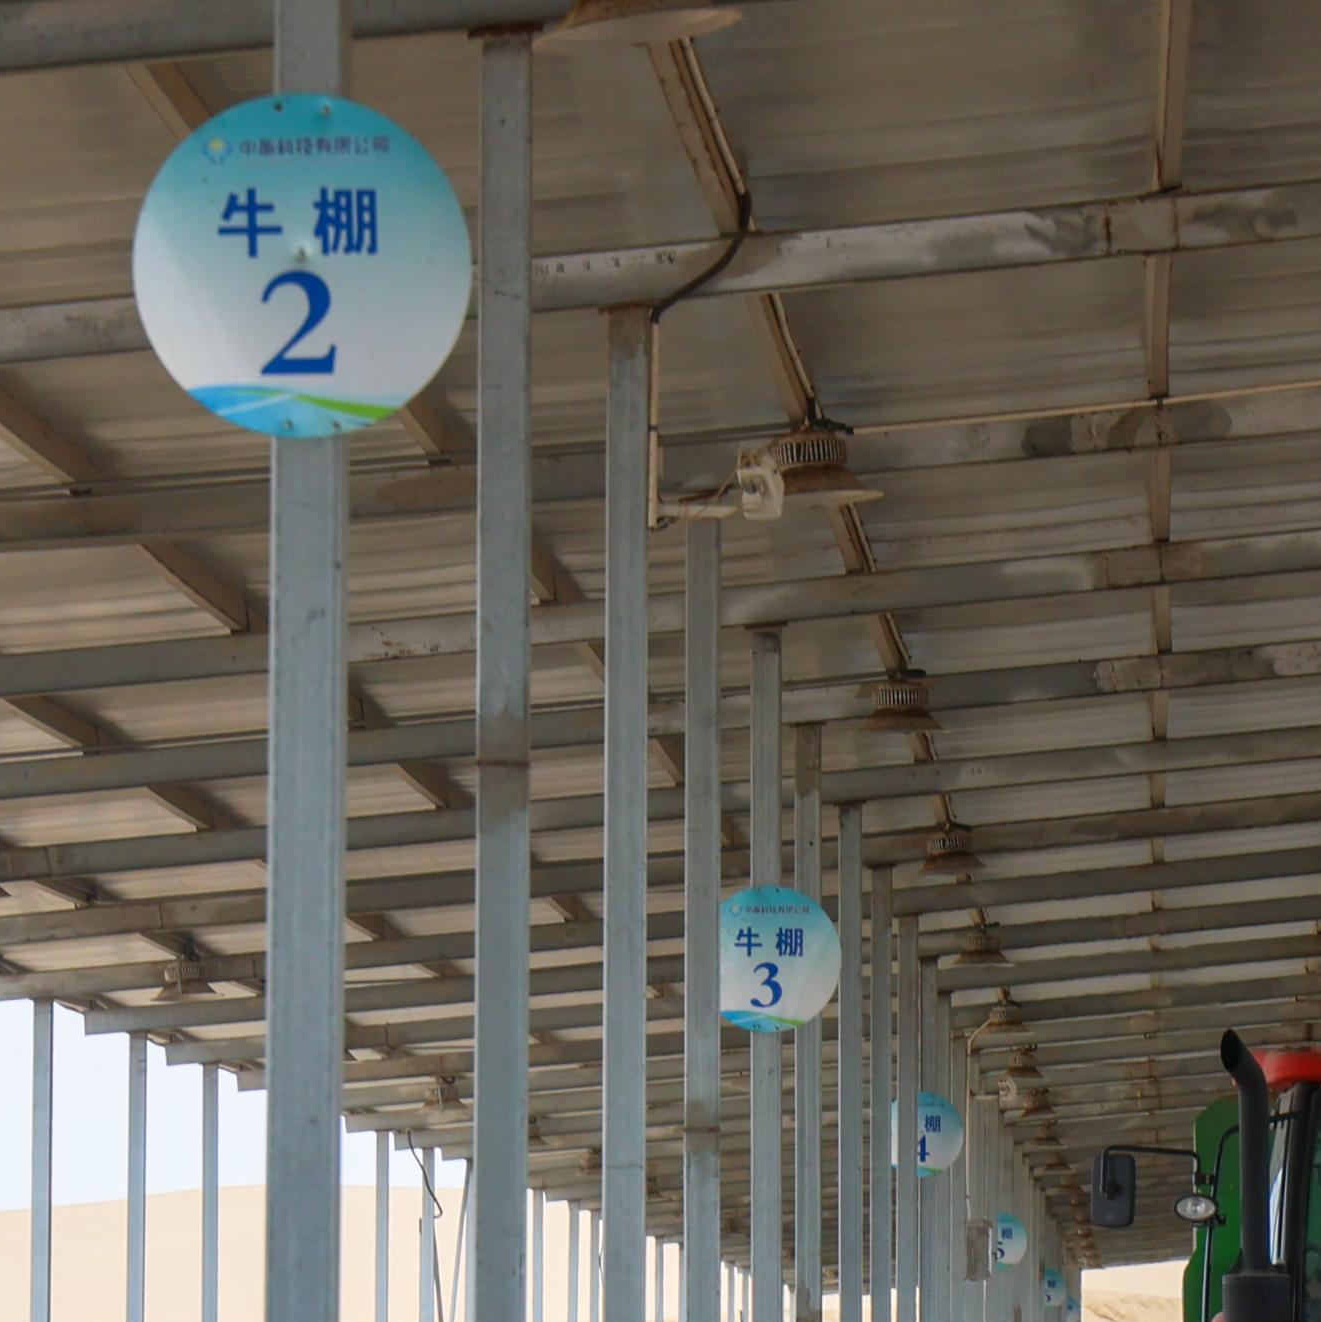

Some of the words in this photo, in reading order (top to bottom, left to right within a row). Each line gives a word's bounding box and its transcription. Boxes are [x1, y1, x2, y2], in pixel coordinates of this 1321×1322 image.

[218, 187, 378, 258] 牛棚
[261, 270, 336, 376] 2
[734, 926, 804, 957] 牛棚
[750, 962, 783, 1008] 3
